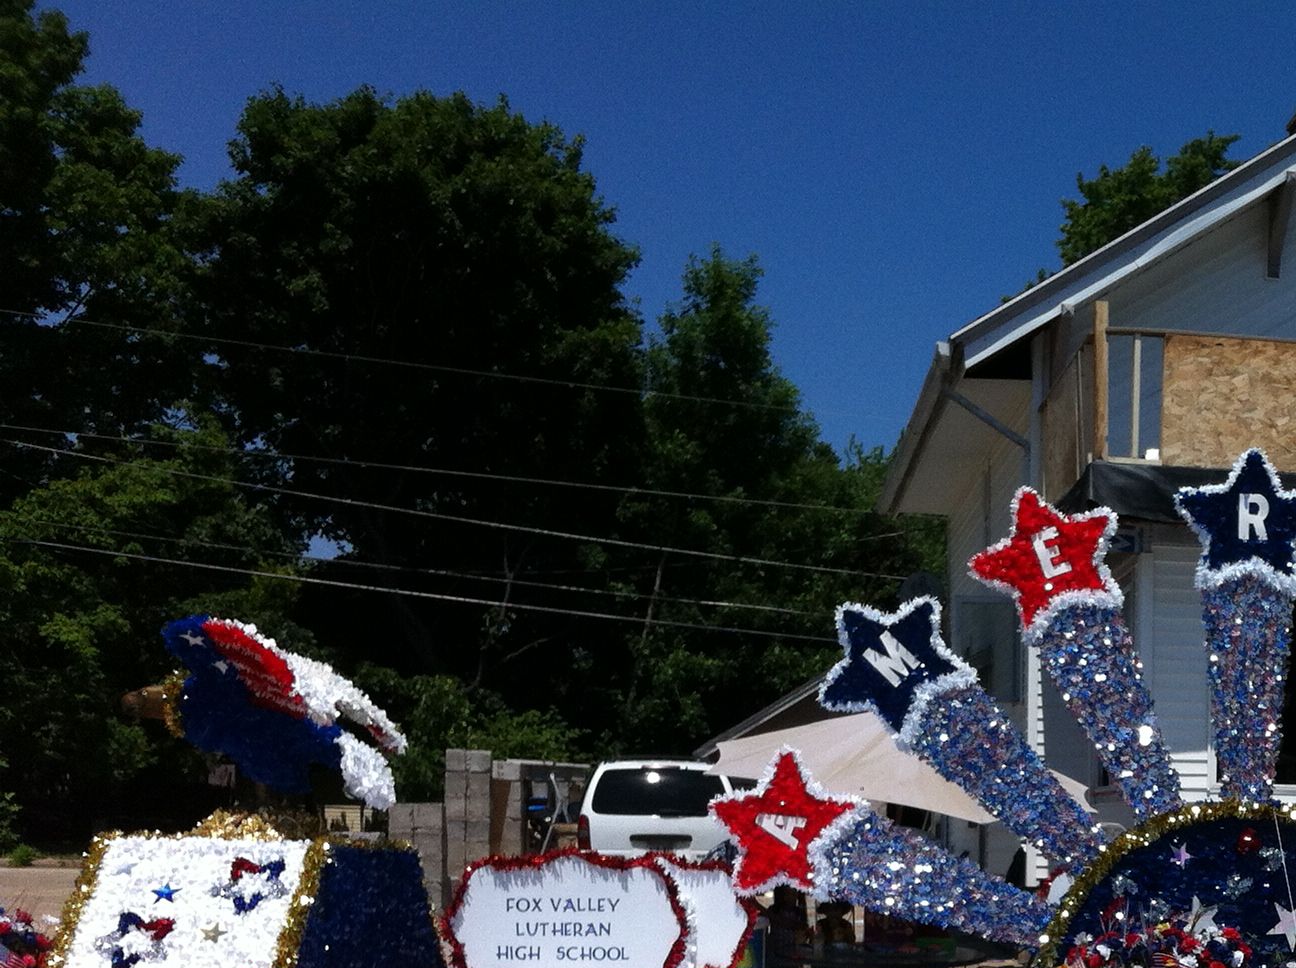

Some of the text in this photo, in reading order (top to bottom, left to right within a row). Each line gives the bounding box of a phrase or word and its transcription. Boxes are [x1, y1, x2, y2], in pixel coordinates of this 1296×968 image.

[755, 812, 807, 850] A
[862, 630, 922, 688] M
[1031, 526, 1073, 580] E
[1237, 493, 1270, 541] R
[506, 898, 620, 912] FOX VALLEY
[516, 922, 611, 937] LUTHERAN
[496, 945, 630, 961] HIGH SCHOOL
